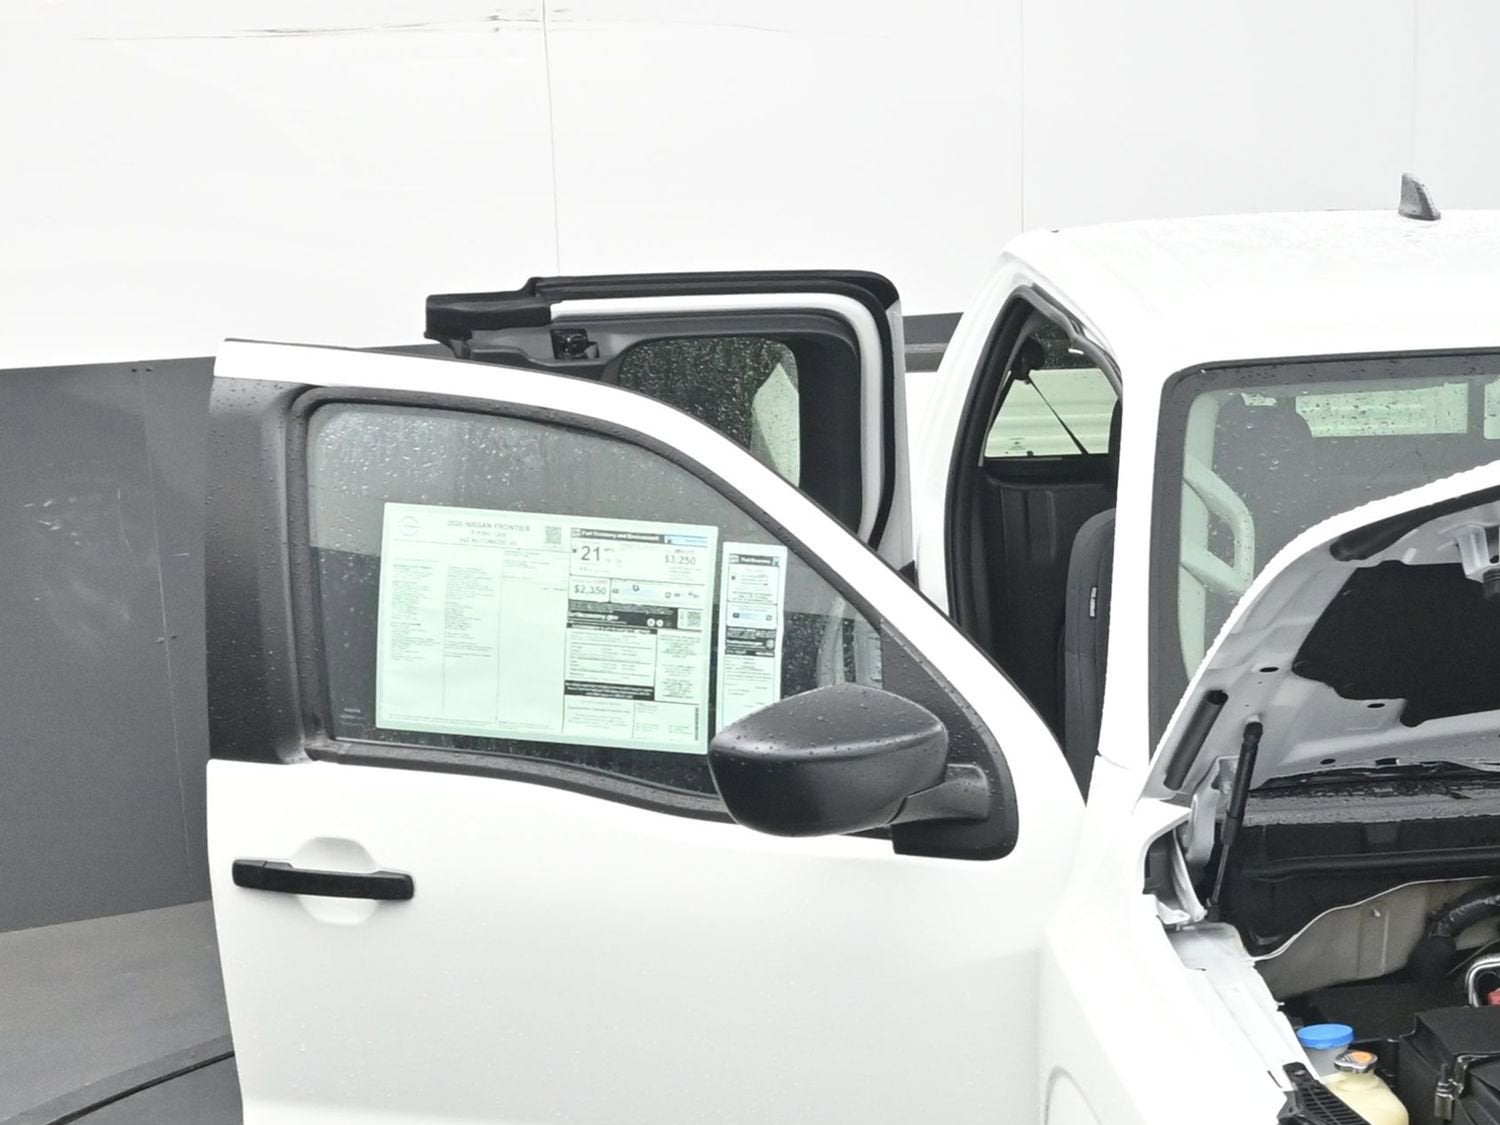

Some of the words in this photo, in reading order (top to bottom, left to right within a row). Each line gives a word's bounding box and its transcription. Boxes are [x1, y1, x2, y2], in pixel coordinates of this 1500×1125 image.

[465, 521, 492, 529] NISSAN
[494, 523, 531, 532] FRONTIER
[581, 545, 600, 561] 21
